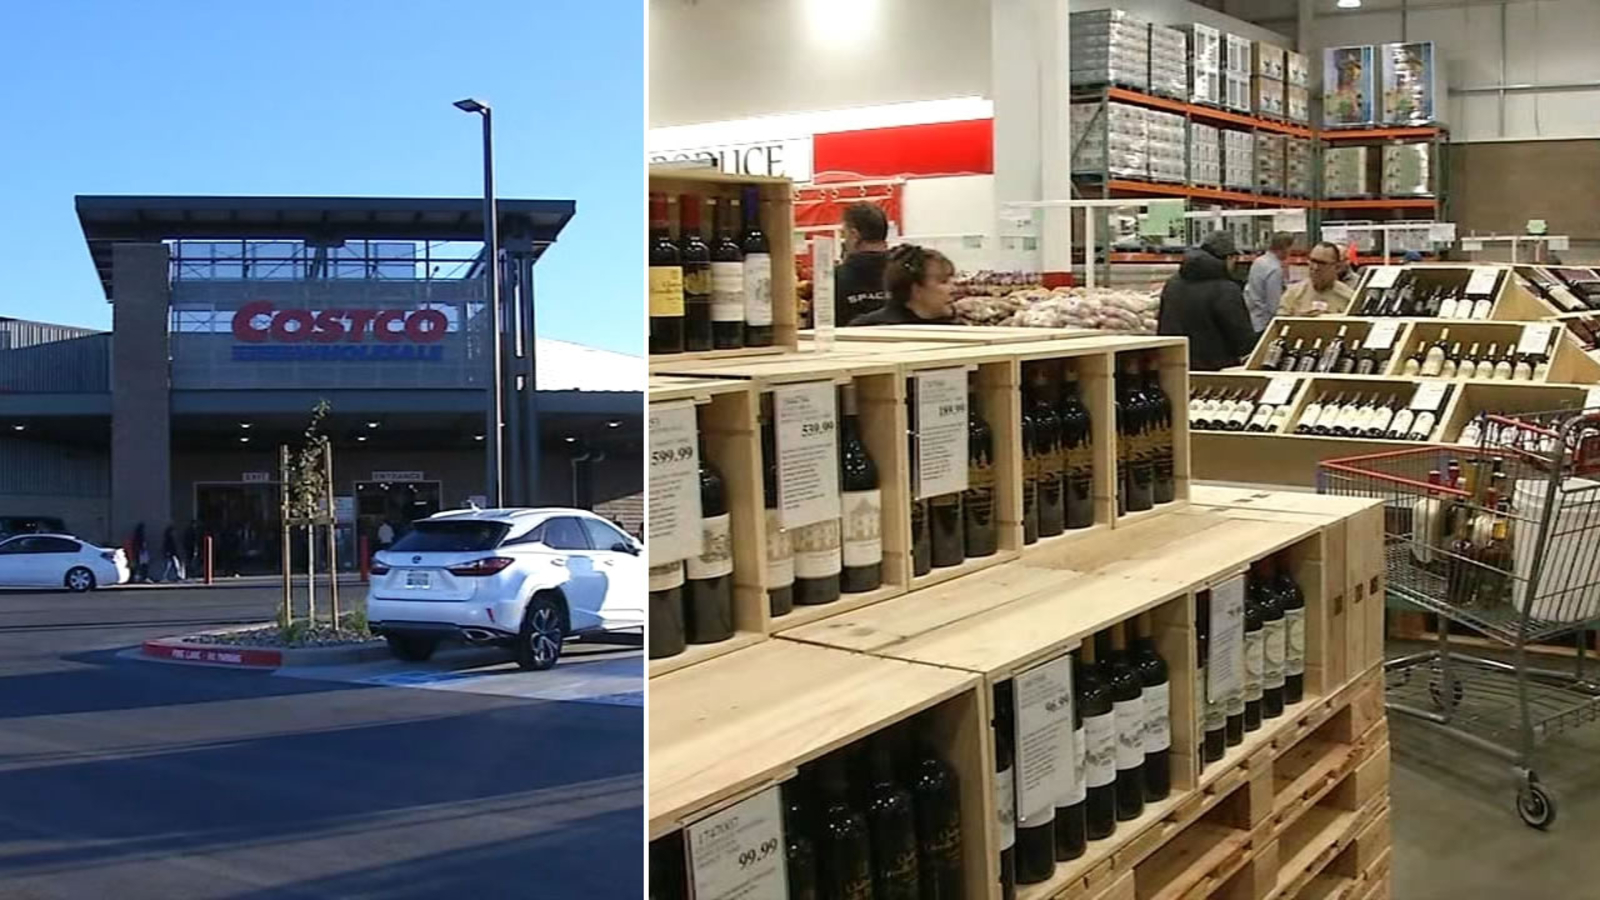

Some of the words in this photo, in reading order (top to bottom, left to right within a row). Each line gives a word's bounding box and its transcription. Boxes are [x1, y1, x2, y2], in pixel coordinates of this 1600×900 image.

[231, 300, 448, 343] COSTCO
[302, 345, 443, 361] WHOLESALE
[801, 420, 834, 438] 539.99
[651, 446, 693, 466] 599.99
[738, 837, 779, 870] 99.99
